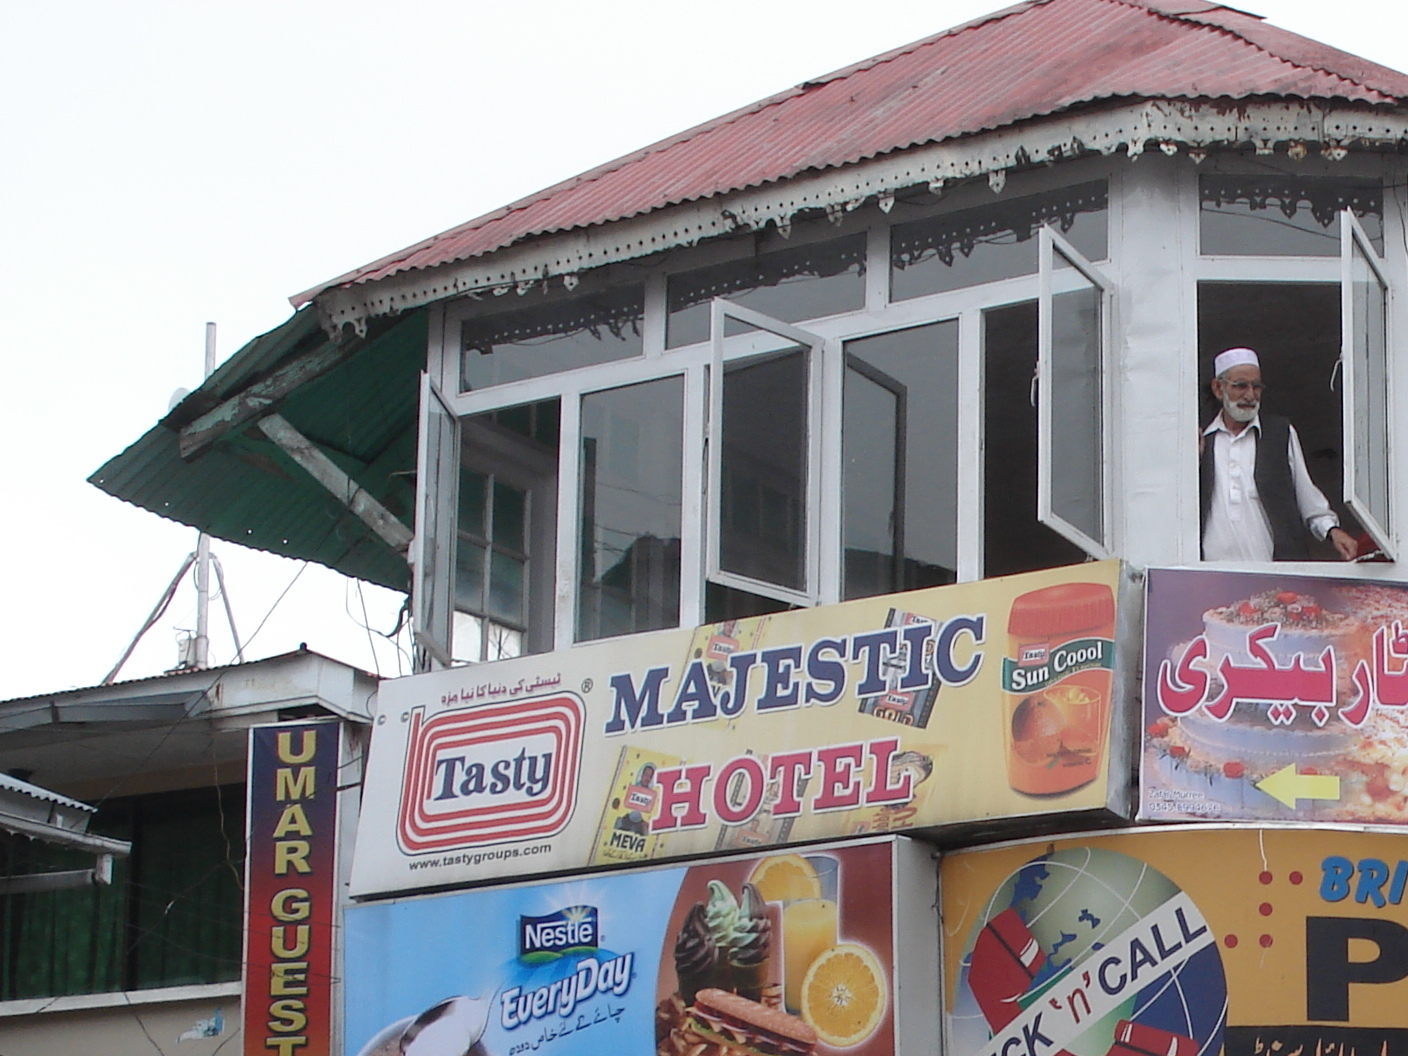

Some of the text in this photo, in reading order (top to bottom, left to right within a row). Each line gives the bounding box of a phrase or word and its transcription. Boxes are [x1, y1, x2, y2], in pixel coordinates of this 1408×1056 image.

[604, 614, 986, 734] MAJESTIC
[1012, 667, 1049, 690] Sun
[1054, 641, 1102, 671] Coool
[1158, 623, 1335, 727] بیکری
[273, 730, 317, 874] UMAR
[434, 747, 552, 800] Tasty
[651, 738, 914, 832] HOTEL
[409, 844, 551, 870] www.tastygroups.com
[610, 832, 646, 852] MEVA
[501, 952, 634, 1030] EveryDay
[1099, 907, 1208, 995] CALL
